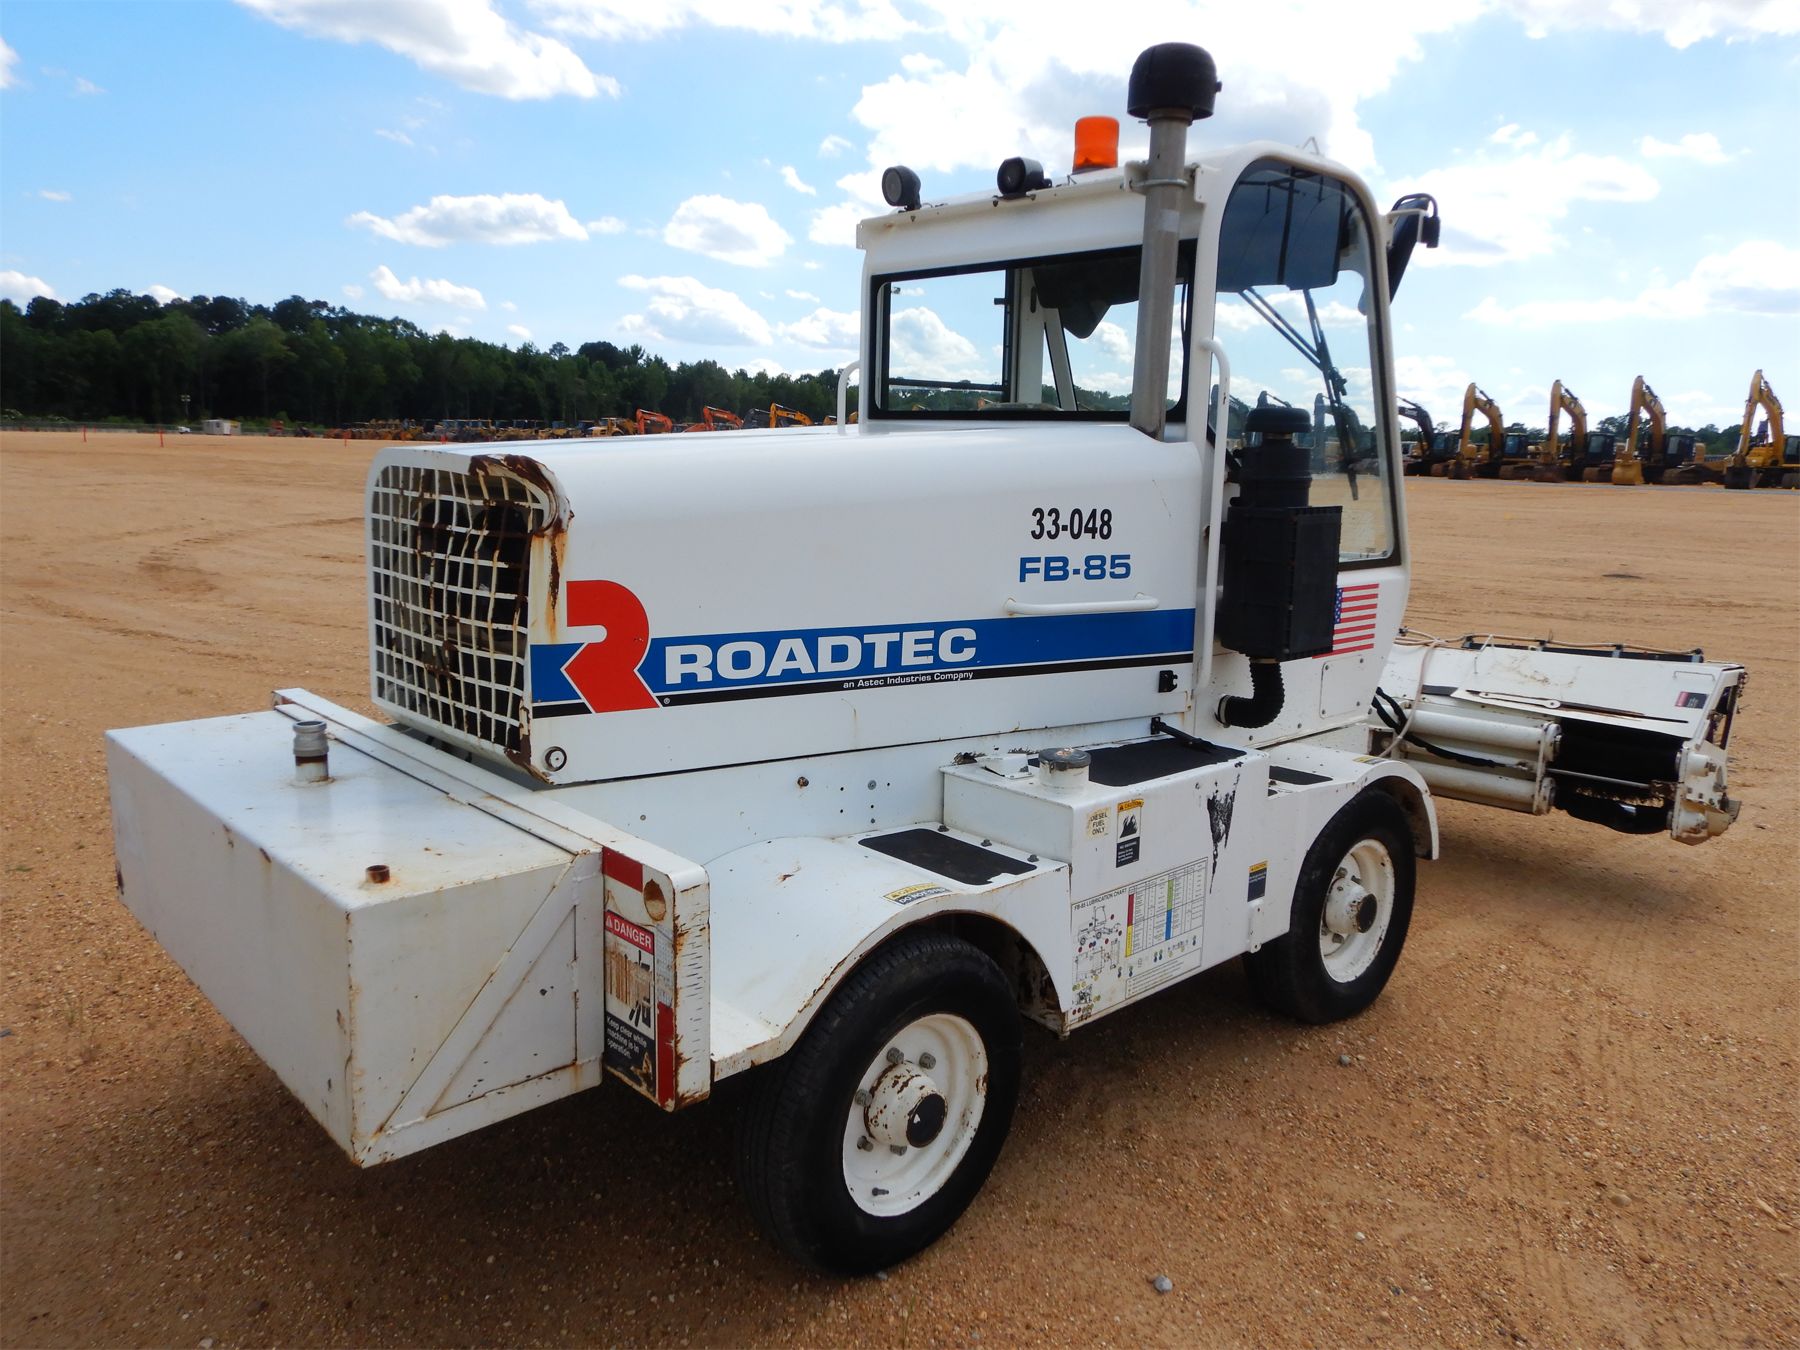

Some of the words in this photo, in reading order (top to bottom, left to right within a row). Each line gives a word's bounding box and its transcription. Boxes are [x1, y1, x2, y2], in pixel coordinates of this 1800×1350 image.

[1031, 507, 1112, 540] 33-048
[1019, 554, 1132, 583] FB-85
[665, 627, 977, 685] ROADTEC
[843, 681, 855, 689] an
[857, 679, 884, 687] Astec
[887, 674, 932, 684] Industries
[934, 672, 974, 681] Company
[1090, 812, 1108, 822] DIESEL
[1086, 892, 1114, 906] LUBRICATION
[1114, 888, 1127, 897] CHART
[614, 919, 652, 949] DANGER
[607, 1016, 619, 1031] Keep
[620, 1026, 632, 1038] clear
